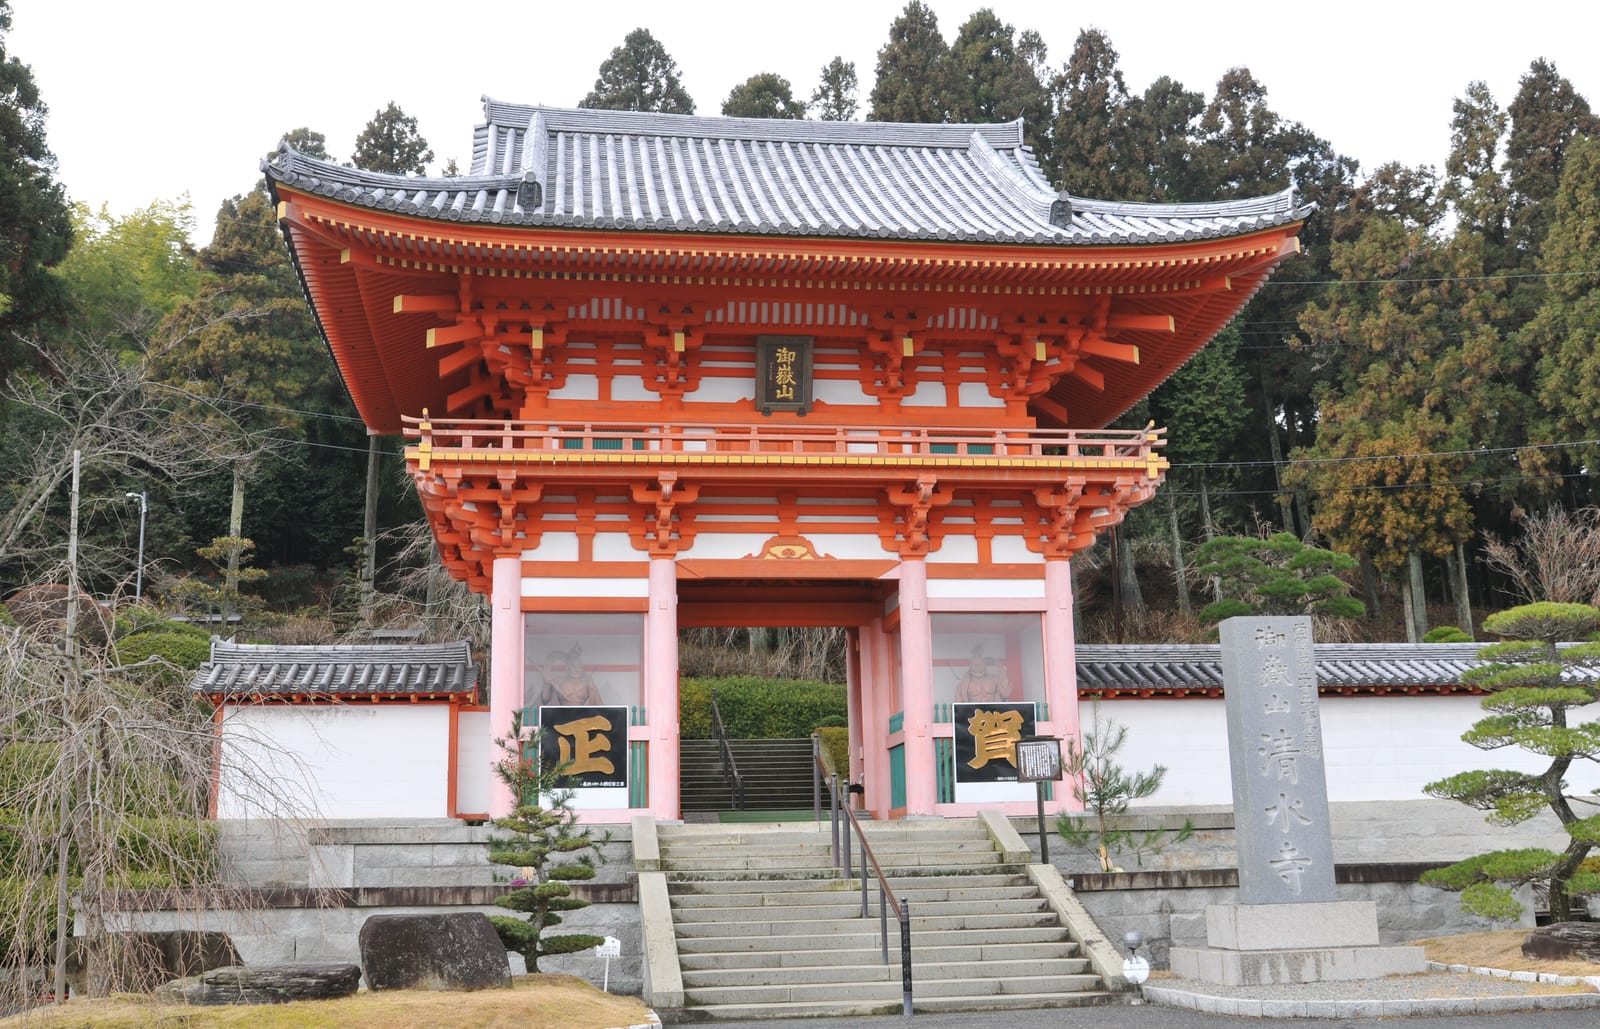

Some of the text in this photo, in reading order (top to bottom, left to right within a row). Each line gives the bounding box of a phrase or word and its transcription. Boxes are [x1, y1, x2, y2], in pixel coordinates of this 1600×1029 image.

[775, 346, 797, 400] 御嶽山
[553, 715, 615, 776] 正
[967, 708, 1025, 770] 賀
